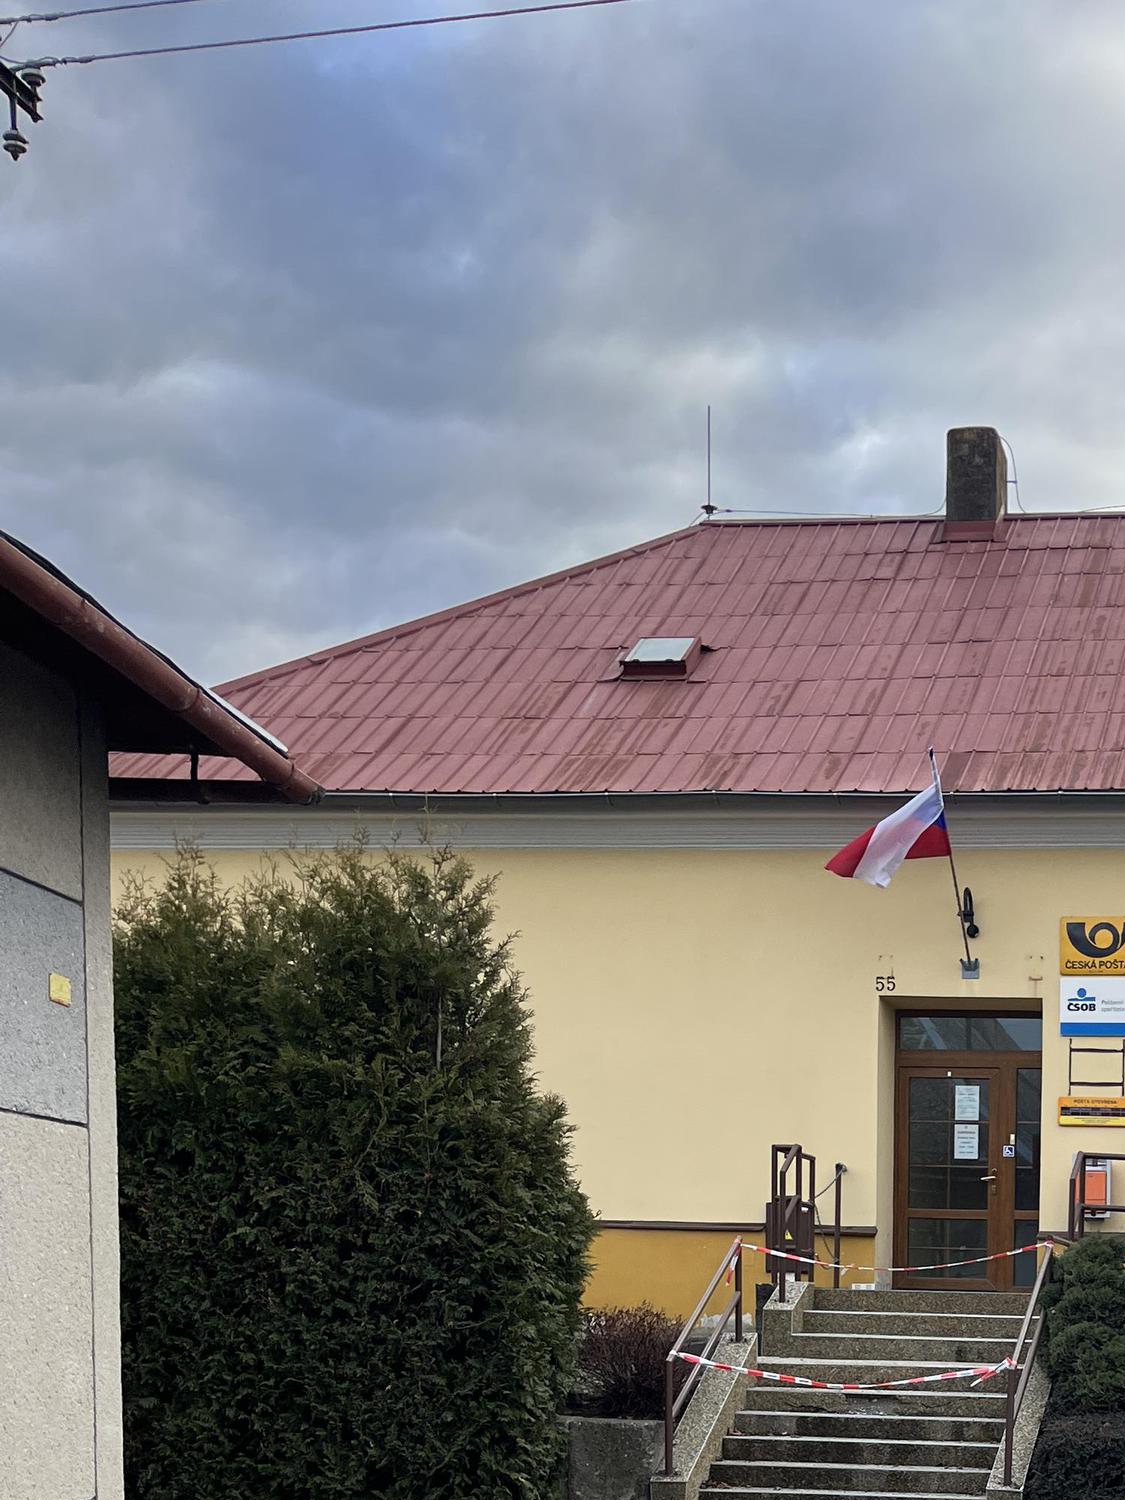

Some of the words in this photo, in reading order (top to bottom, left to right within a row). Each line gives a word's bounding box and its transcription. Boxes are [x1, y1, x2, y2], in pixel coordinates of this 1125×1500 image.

[1065, 959, 1097, 969] ČESKÁ
[875, 976, 896, 991] 55
[1067, 1002, 1096, 1012] ČSOB
